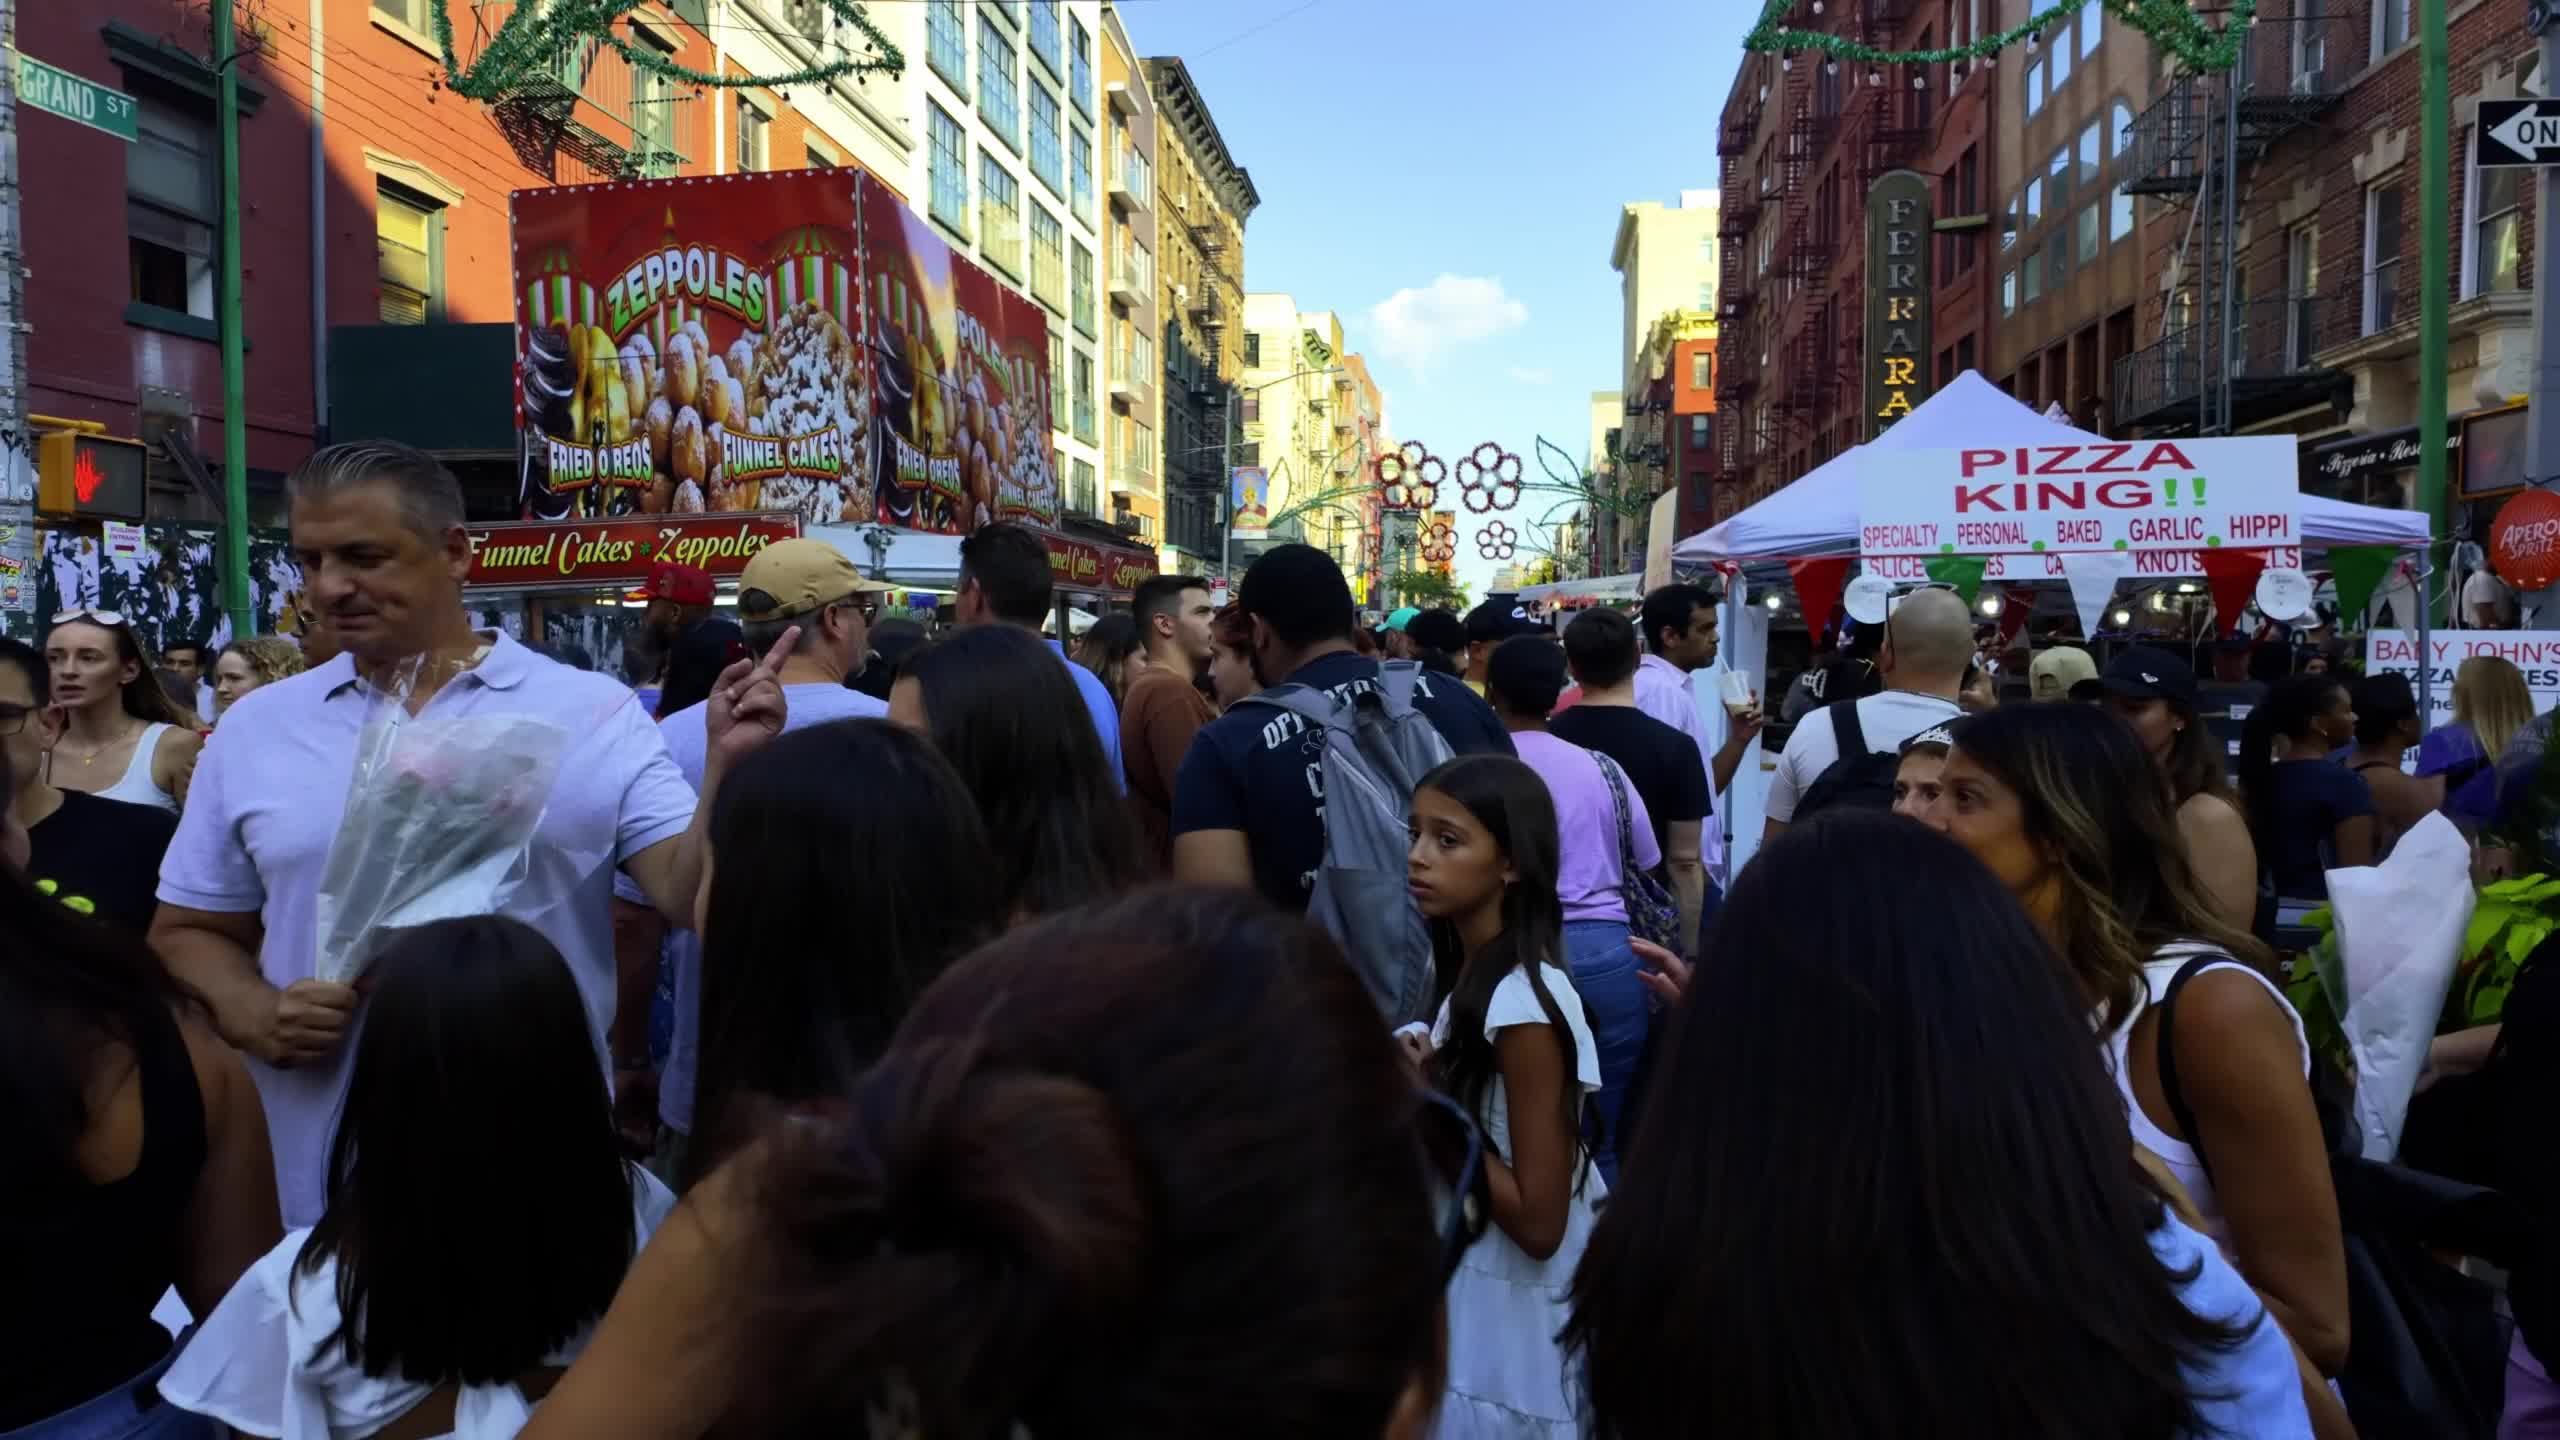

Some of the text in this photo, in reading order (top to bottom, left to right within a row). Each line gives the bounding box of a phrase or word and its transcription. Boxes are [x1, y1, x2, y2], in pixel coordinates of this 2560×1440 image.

[22, 63, 130, 119] GRAND ST
[607, 247, 765, 334] ZEPPOLES
[1876, 200, 1918, 416] FERRARA
[551, 446, 593, 485] FRIED
[723, 429, 841, 477] FUNNEL CAKES
[896, 437, 926, 480] FRIED
[1960, 442, 2196, 477] PIZZA
[2326, 450, 2377, 478] Pizzeria
[1864, 514, 2288, 549] SPECIALTY PERSONAL BAKED GARLIC HIPPI
[2499, 518, 2560, 550] APERO
[468, 531, 556, 569] Funnel
[558, 529, 635, 574] Cakes
[1071, 547, 1097, 580] Cakes
[2136, 551, 2204, 573] KNOTS
